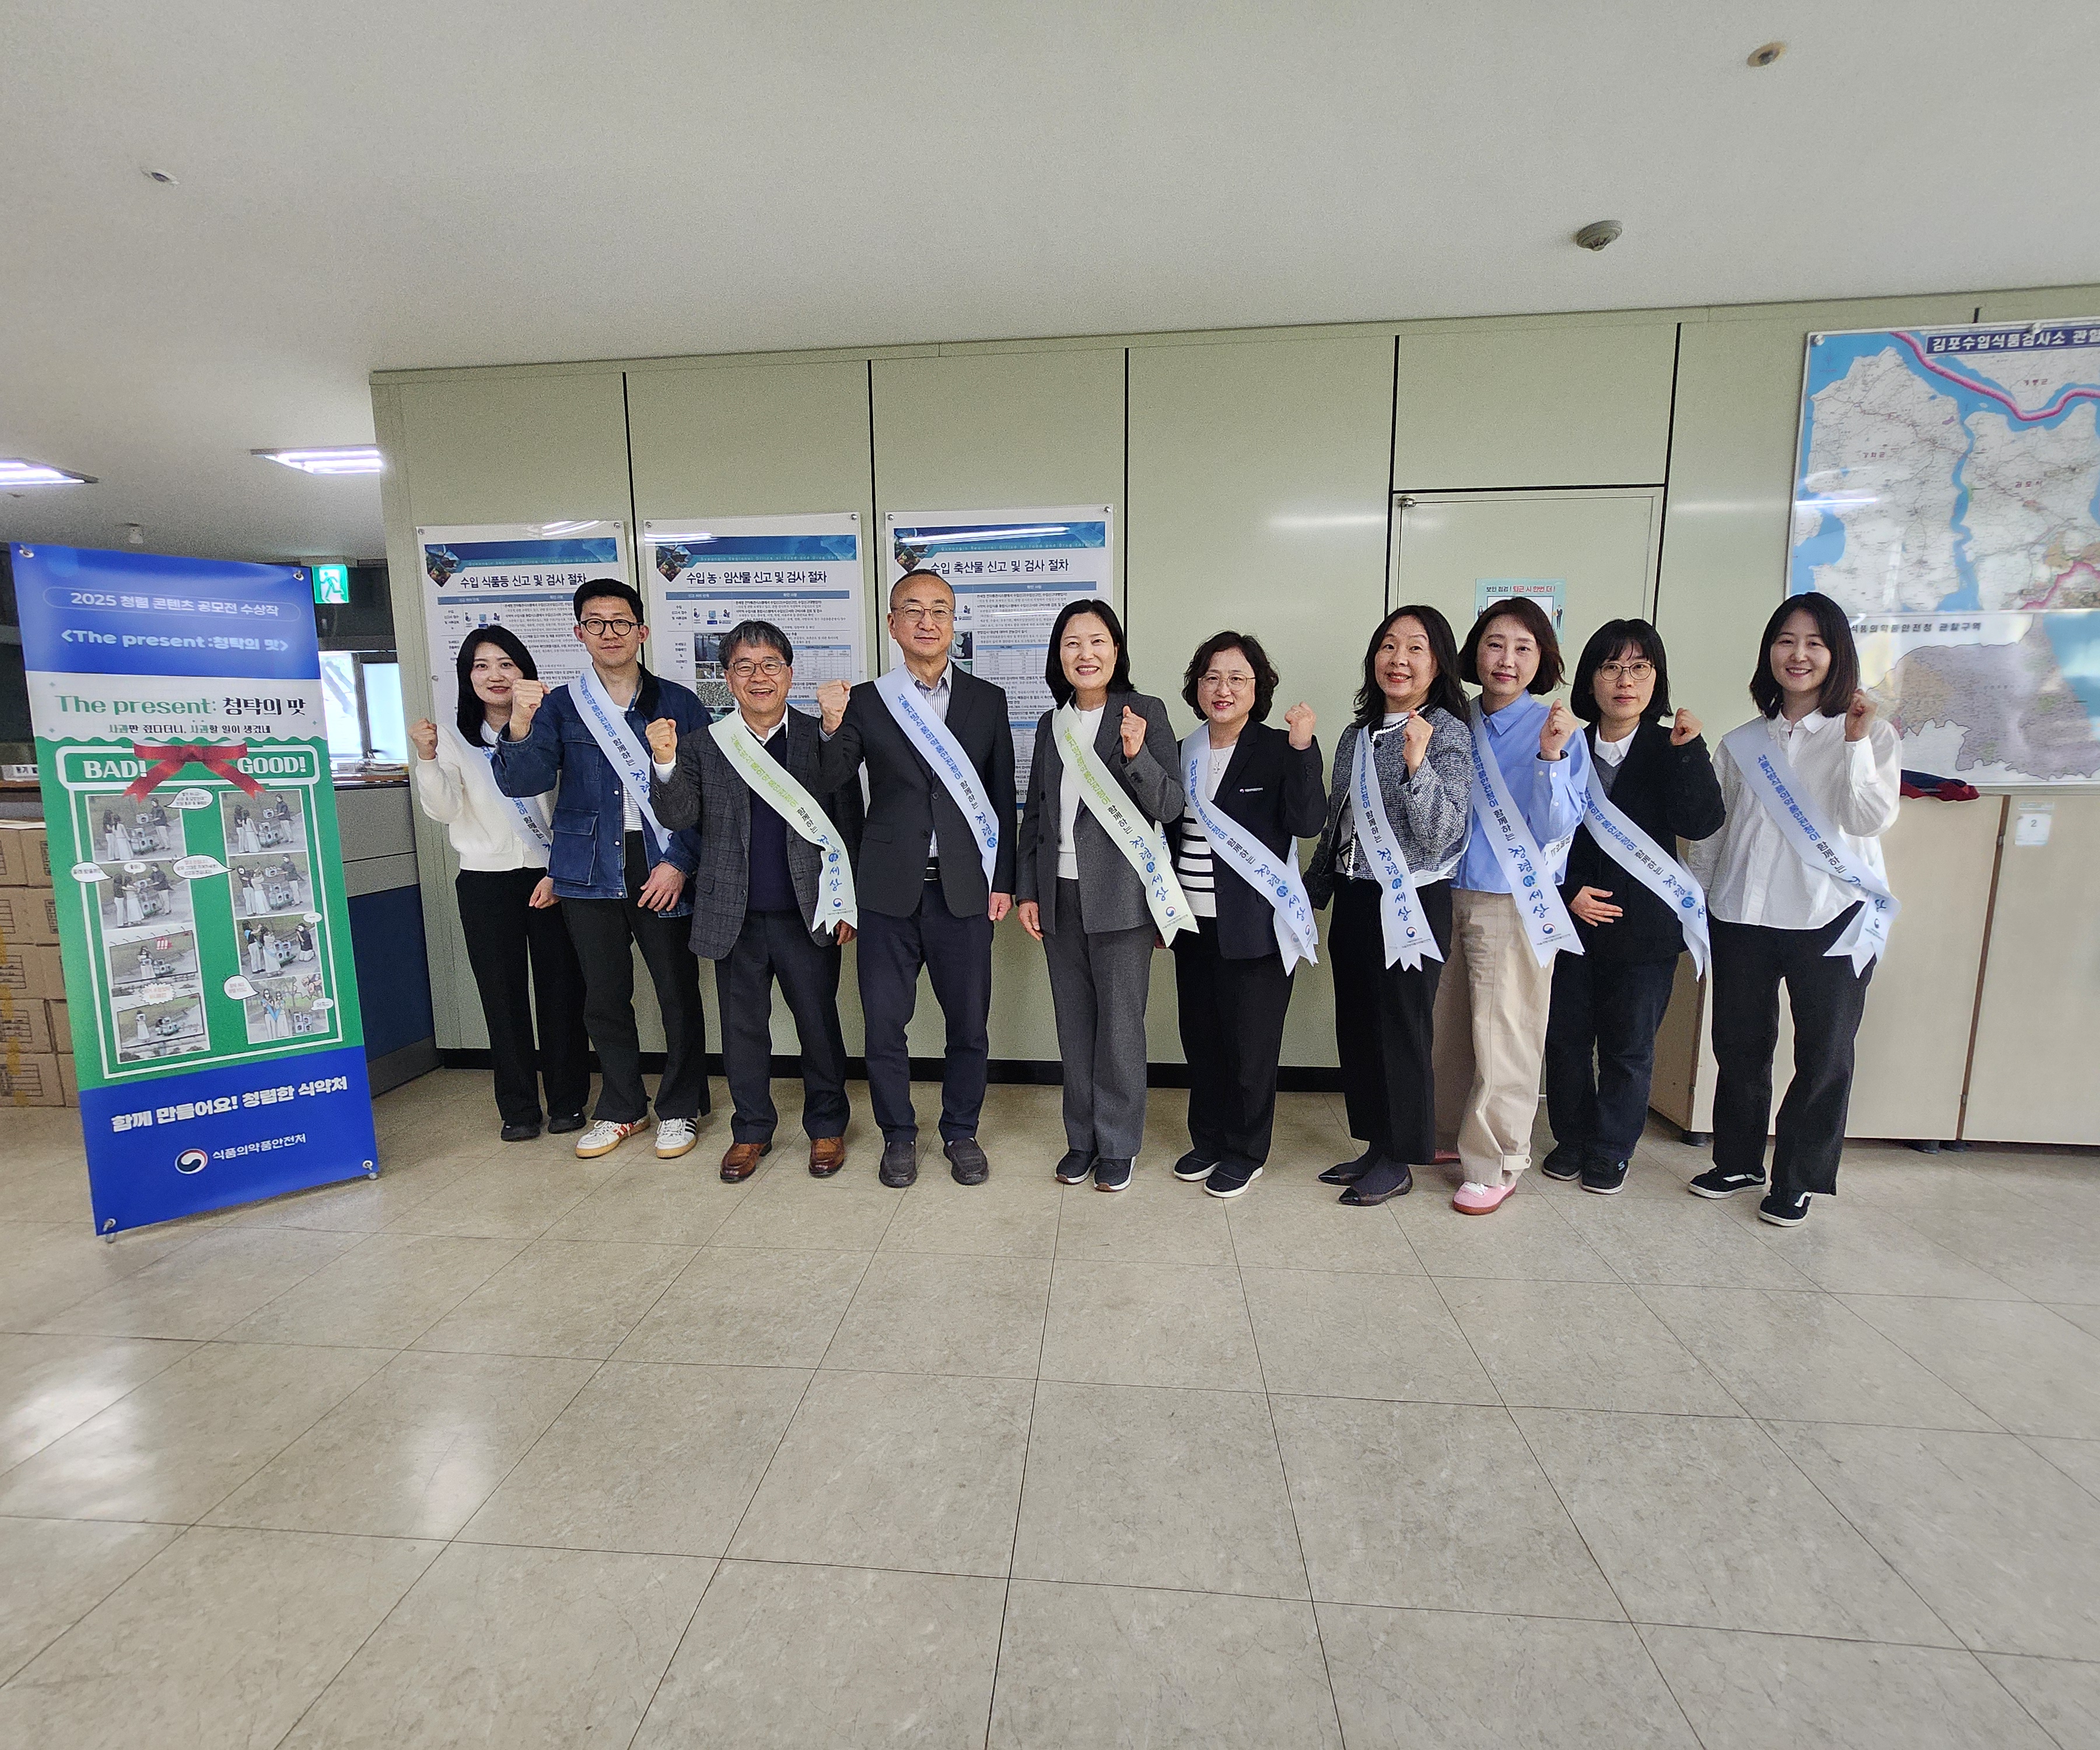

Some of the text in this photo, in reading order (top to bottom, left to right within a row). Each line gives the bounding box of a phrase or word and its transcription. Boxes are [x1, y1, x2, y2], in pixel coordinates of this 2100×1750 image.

[686, 572, 705, 584] 수입
[753, 570, 772, 583] 신고
[775, 570, 784, 583] 및
[786, 570, 805, 583] 검사
[808, 570, 827, 583] 절차
[930, 558, 1069, 575] 수입 축산물 신고 및 검사 절차
[460, 572, 587, 589] 수입 식품등 신고 및 검사 절차
[70, 592, 279, 617] 2025 청렴 콘텐츠 공모전 수상작
[1938, 622, 1981, 632] 관할구역
[55, 695, 306, 716] The present: 청탁의 맛
[222, 724, 240, 734] 일이
[243, 724, 271, 734] 생겼네
[612, 738, 636, 766] 함께하는
[898, 692, 992, 836] 서울지방식품의약품안전청이 함께하는 청렴
[82, 760, 148, 779] BAD!
[236, 756, 307, 775] GOOD!
[1757, 753, 1847, 874] 서울지방식품의약품안전청이 함께하는
[2031, 820, 2037, 828] 2
[1107, 804, 1133, 835] 함께하는
[1129, 835, 1153, 860] 청렴
[1151, 873, 1170, 902] 세상
[1364, 809, 1382, 844] 함께하는
[1376, 848, 1401, 875] 청렴
[1394, 892, 1412, 922] 세상
[1493, 808, 1516, 841] 함께하는
[1507, 845, 1534, 873] 청렴
[1529, 888, 1550, 919] 세상
[830, 866, 842, 891] 세상
[1226, 838, 1256, 865] 함께하는
[1254, 863, 1281, 887] 청렴
[1288, 894, 1306, 922] 세상
[1633, 849, 1664, 876] 함께하는
[1662, 874, 1686, 898] 청렴
[111, 1076, 348, 1132] 함께 만들어요! 청렴한 식약처
[212, 1133, 306, 1160] 식품의약품안전처
